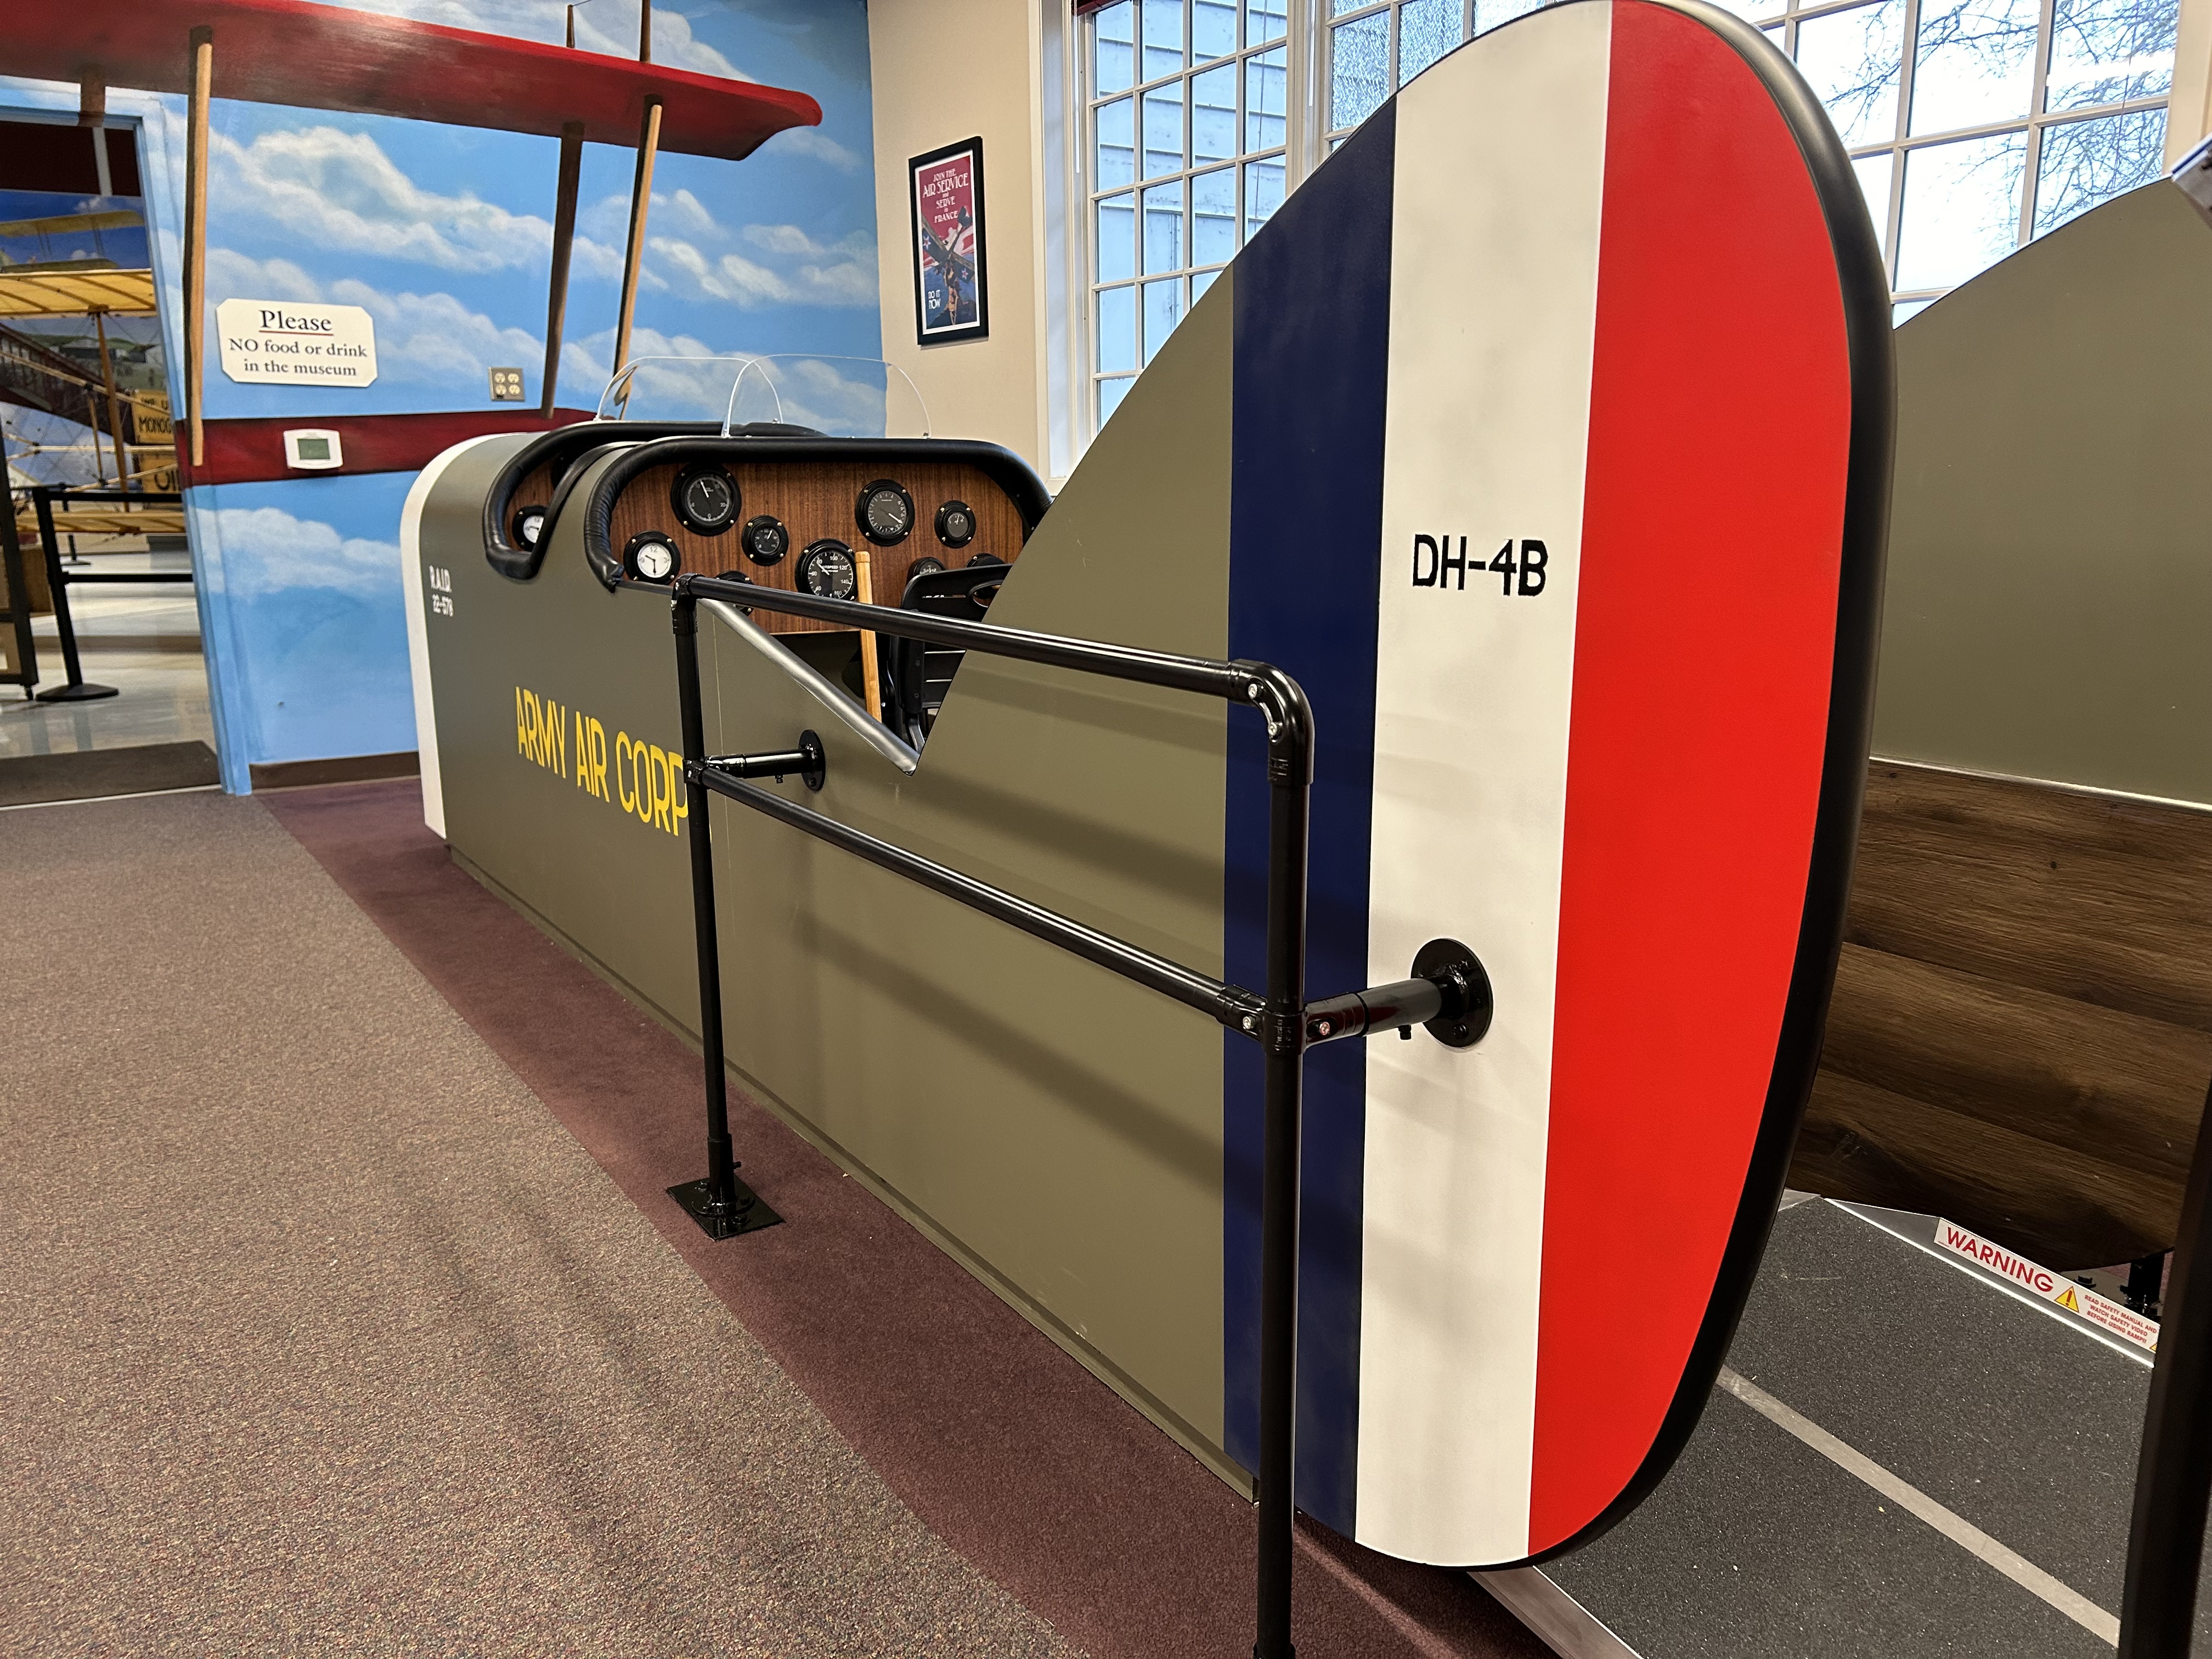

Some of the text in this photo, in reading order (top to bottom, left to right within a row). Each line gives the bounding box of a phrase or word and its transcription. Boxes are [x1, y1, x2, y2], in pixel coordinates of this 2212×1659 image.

[922, 173, 969, 198] AIR SERVICE
[935, 196, 956, 208] SERVE
[934, 210, 958, 223] FRANCE
[928, 298, 941, 309] NOW
[259, 309, 332, 331] Please
[229, 338, 368, 357] NO food or drink
[244, 359, 357, 376] in the museum
[1412, 533, 1548, 597] DH-4B
[515, 686, 712, 843] ARMY AIR CORP
[1948, 1226, 2054, 1292] WARNING
[2085, 1295, 2157, 1333] READ SAFETY MANUAL AND
[2086, 1311, 2107, 1324] BEFORE
[2108, 1321, 2126, 1333] USING
[2090, 1304, 2148, 1336] WATCH SAFETY VIDEO
